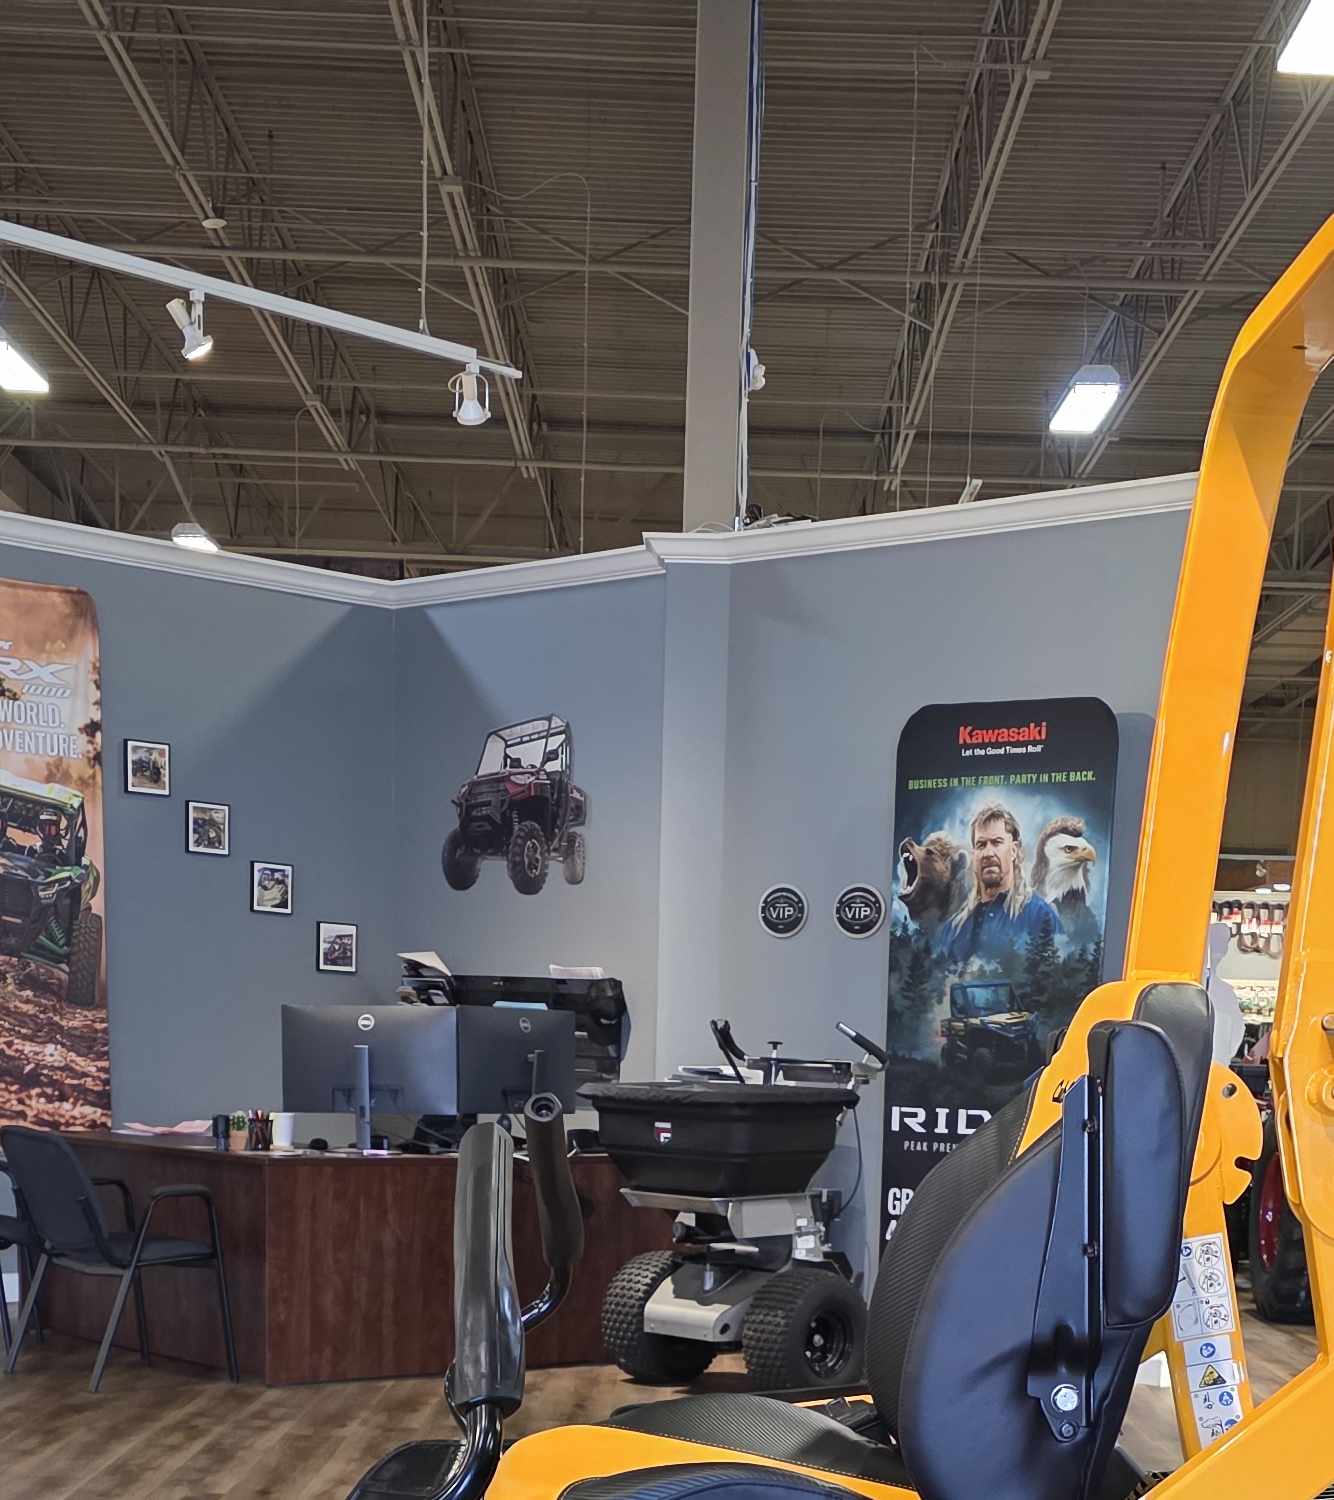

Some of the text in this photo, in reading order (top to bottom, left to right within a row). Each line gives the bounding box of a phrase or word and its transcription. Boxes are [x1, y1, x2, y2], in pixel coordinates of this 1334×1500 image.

[22, 684, 72, 698] 1000
[958, 721, 1047, 745] Kawasaki
[961, 748, 973, 757] Let
[974, 747, 985, 756] the
[986, 746, 1004, 755] Good
[908, 770, 1096, 790] BUSINESS IN THE FRONT. PARTY IN THE BACK.
[769, 907, 794, 919] VIP
[845, 907, 871, 919] VIP
[904, 1140, 928, 1152] PEAK
